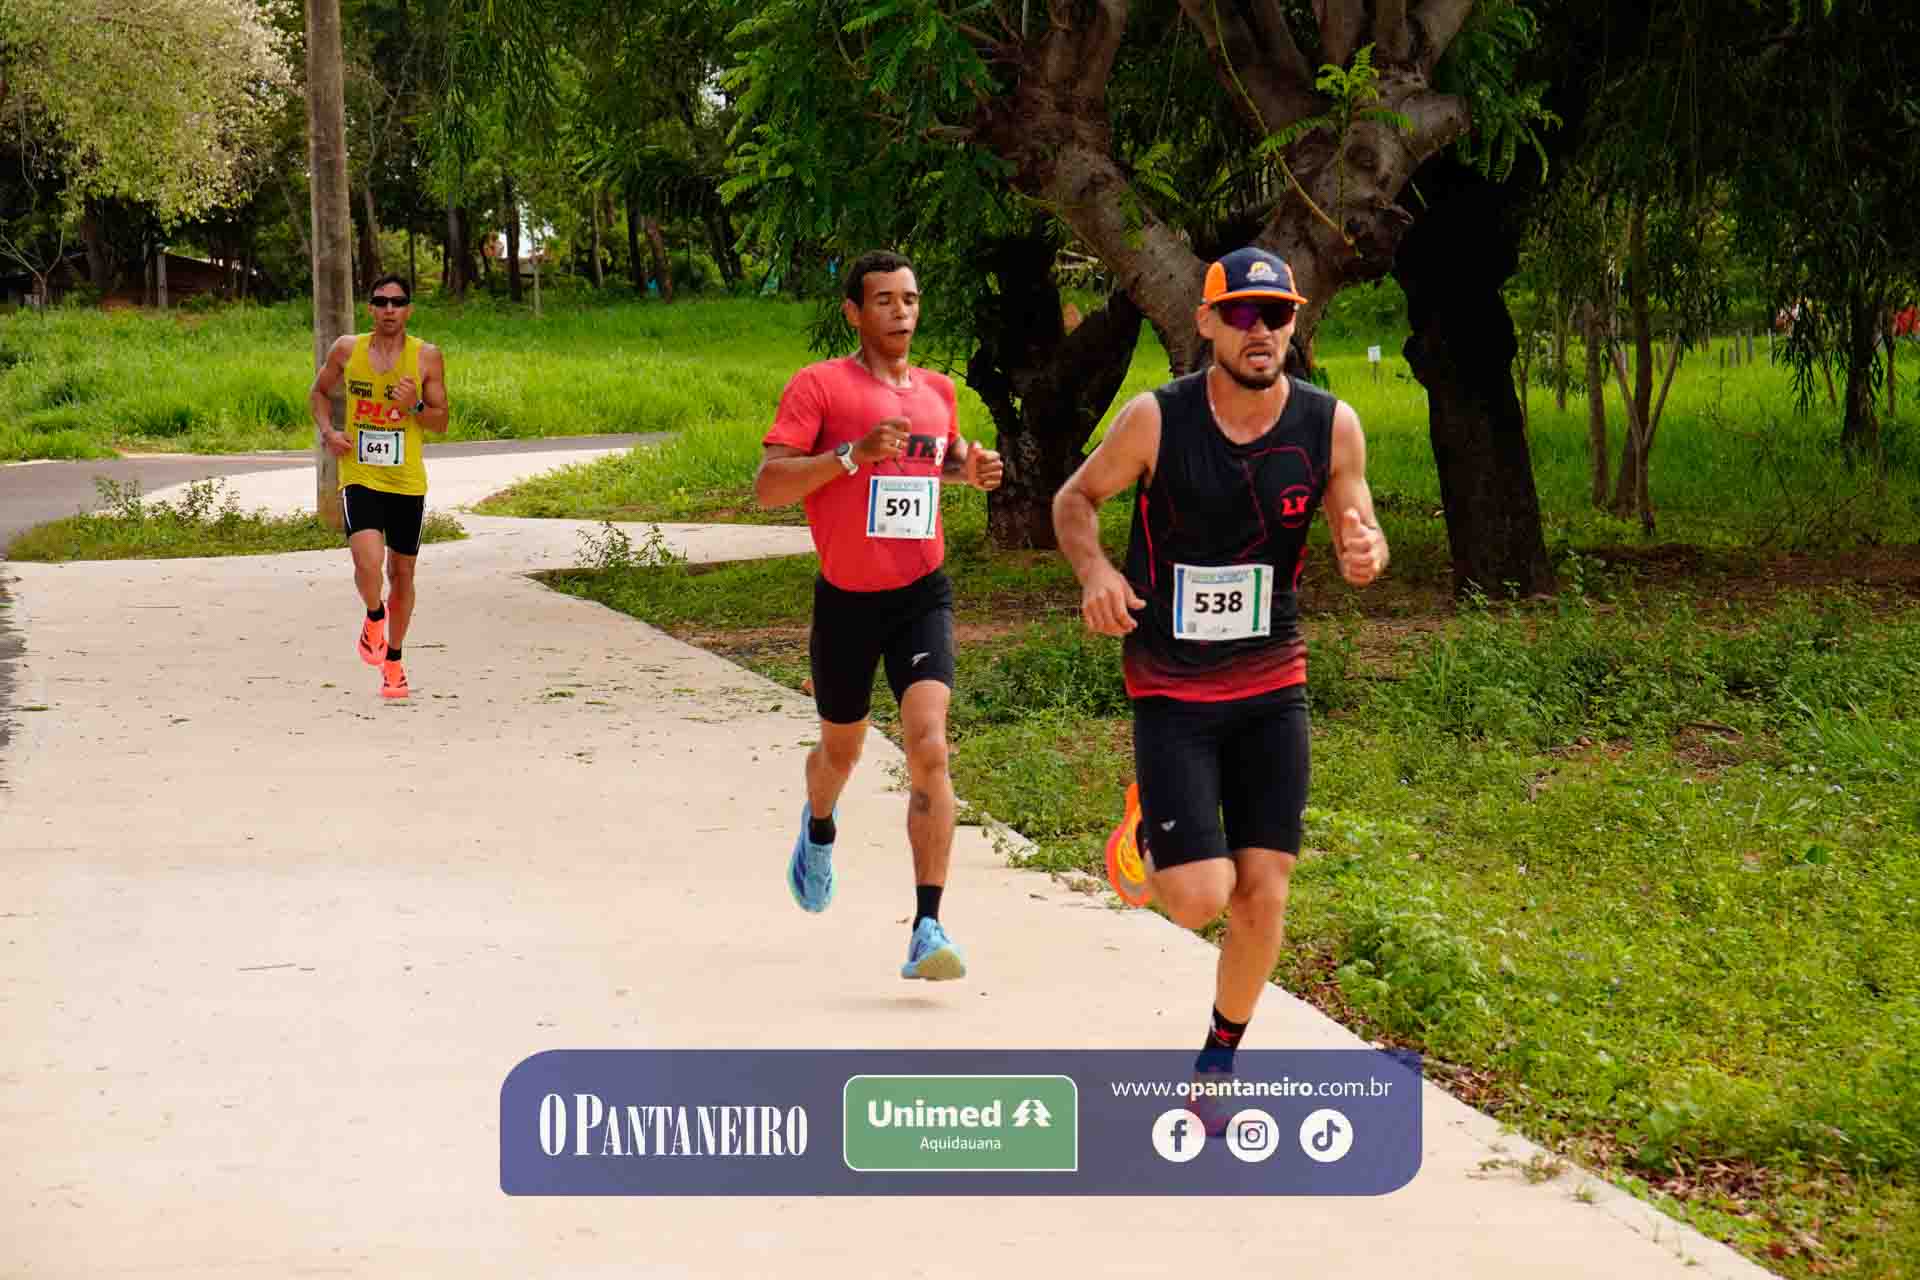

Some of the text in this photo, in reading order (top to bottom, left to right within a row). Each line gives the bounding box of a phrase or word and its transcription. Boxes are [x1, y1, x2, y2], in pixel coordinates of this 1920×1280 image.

[367, 443, 388, 453] 641
[887, 499, 919, 516] 591
[1195, 591, 1242, 613] 538
